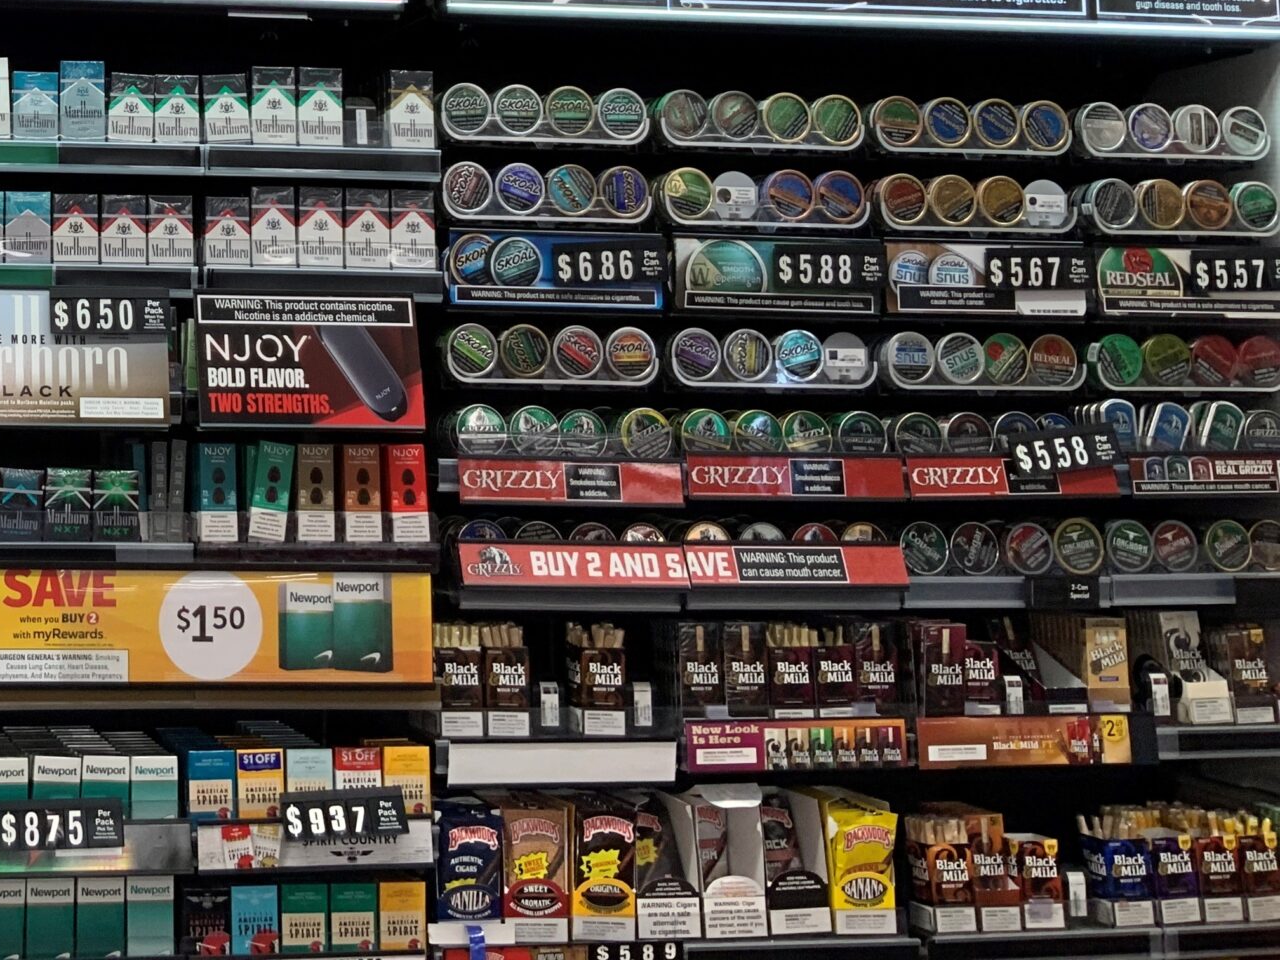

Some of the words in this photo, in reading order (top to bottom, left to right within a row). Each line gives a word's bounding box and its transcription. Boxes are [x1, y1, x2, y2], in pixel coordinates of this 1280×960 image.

[463, 469, 563, 491] GRIZZLY
[530, 551, 581, 577] BUY
[586, 553, 603, 577] 2
[610, 552, 660, 578] AND
[668, 552, 732, 577] SAVE
[2, 569, 116, 608] SAVE
[336, 580, 379, 593] Newport
[445, 663, 478, 675] Black
[452, 672, 479, 686] Mild
[448, 826, 498, 852] BACKWOODS
